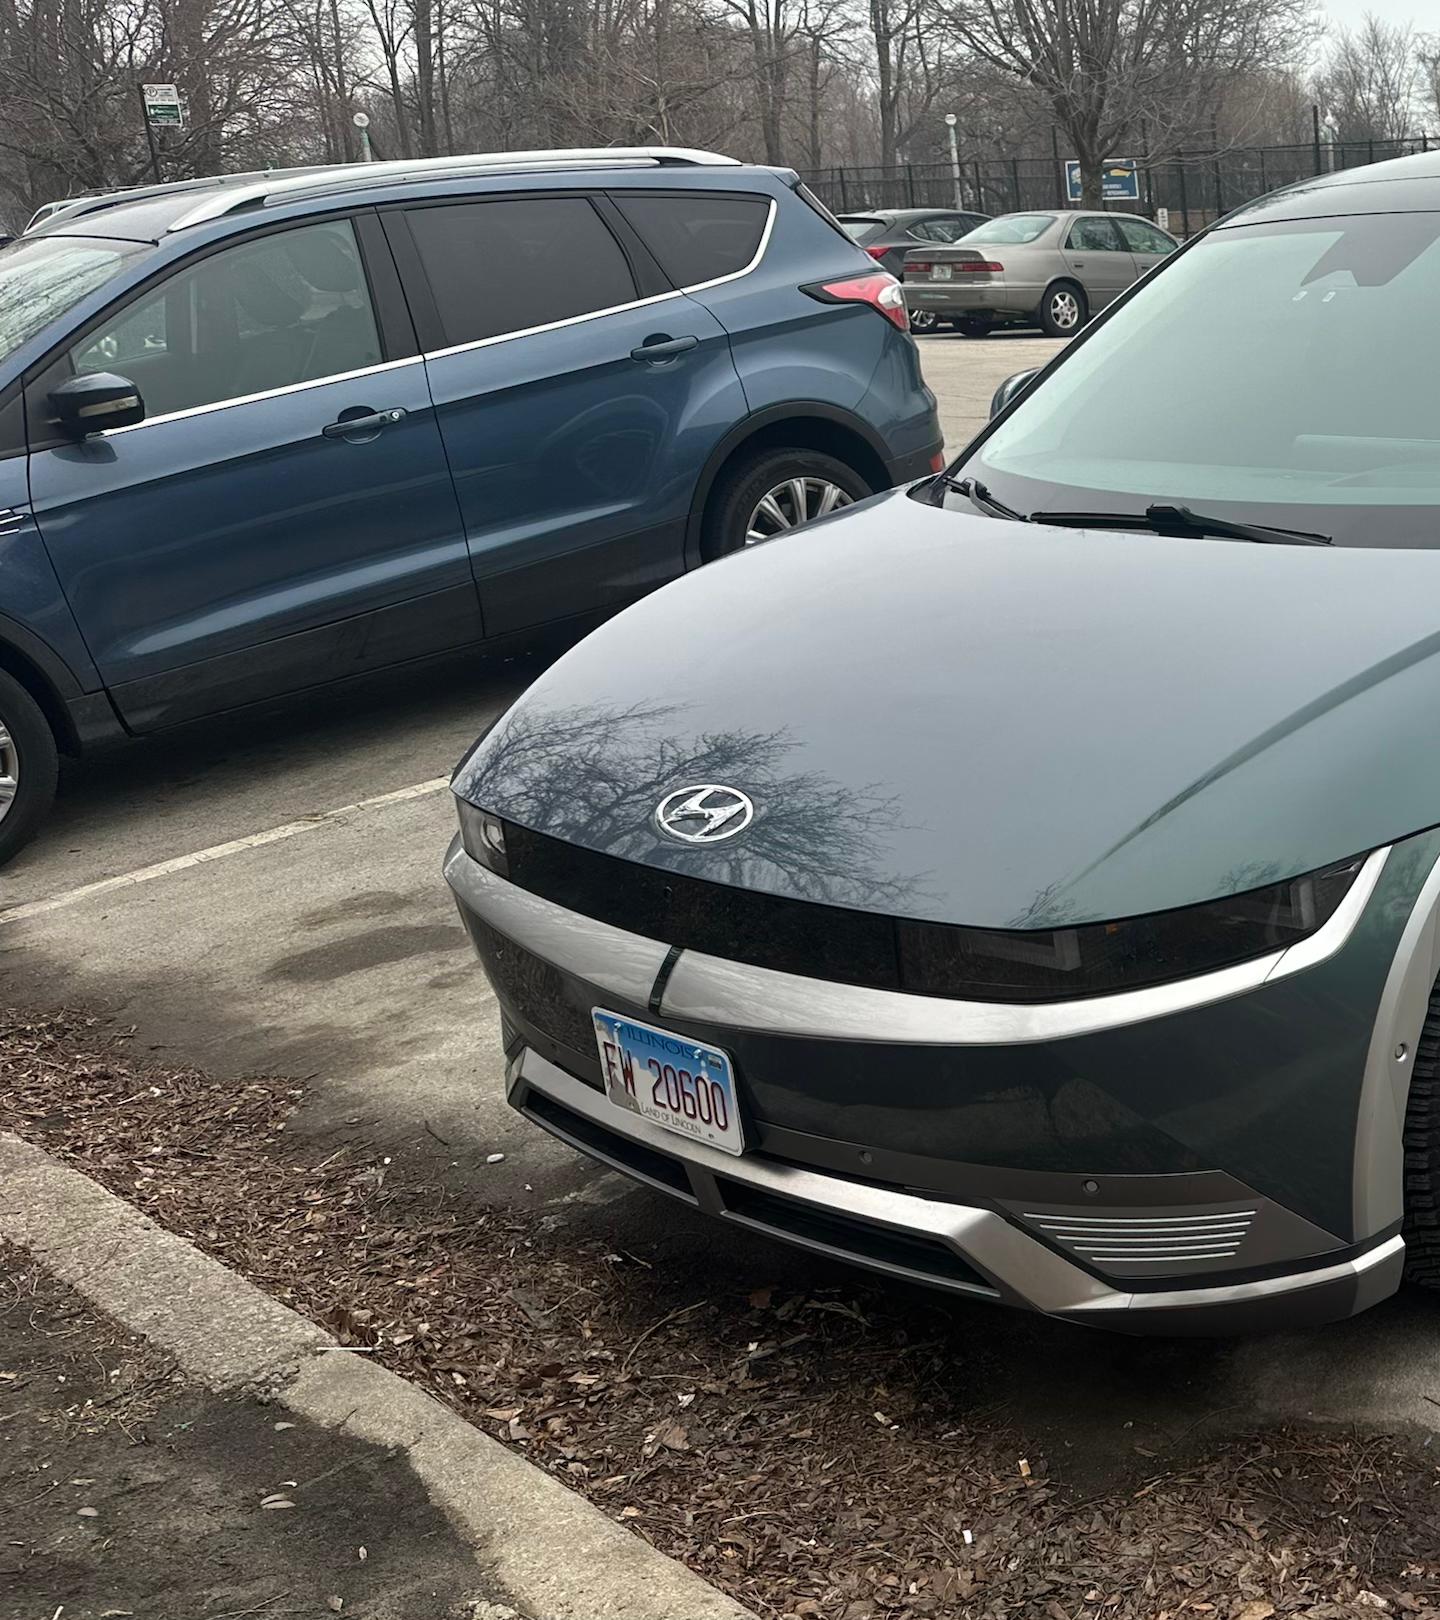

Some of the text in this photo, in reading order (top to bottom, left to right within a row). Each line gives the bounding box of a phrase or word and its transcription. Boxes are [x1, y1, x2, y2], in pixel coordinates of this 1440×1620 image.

[627, 1027, 695, 1060] ILLINOIS
[603, 1041, 728, 1131] FW 20600
[641, 1102, 660, 1119] LAND
[671, 1114, 702, 1134] LINCOLN
